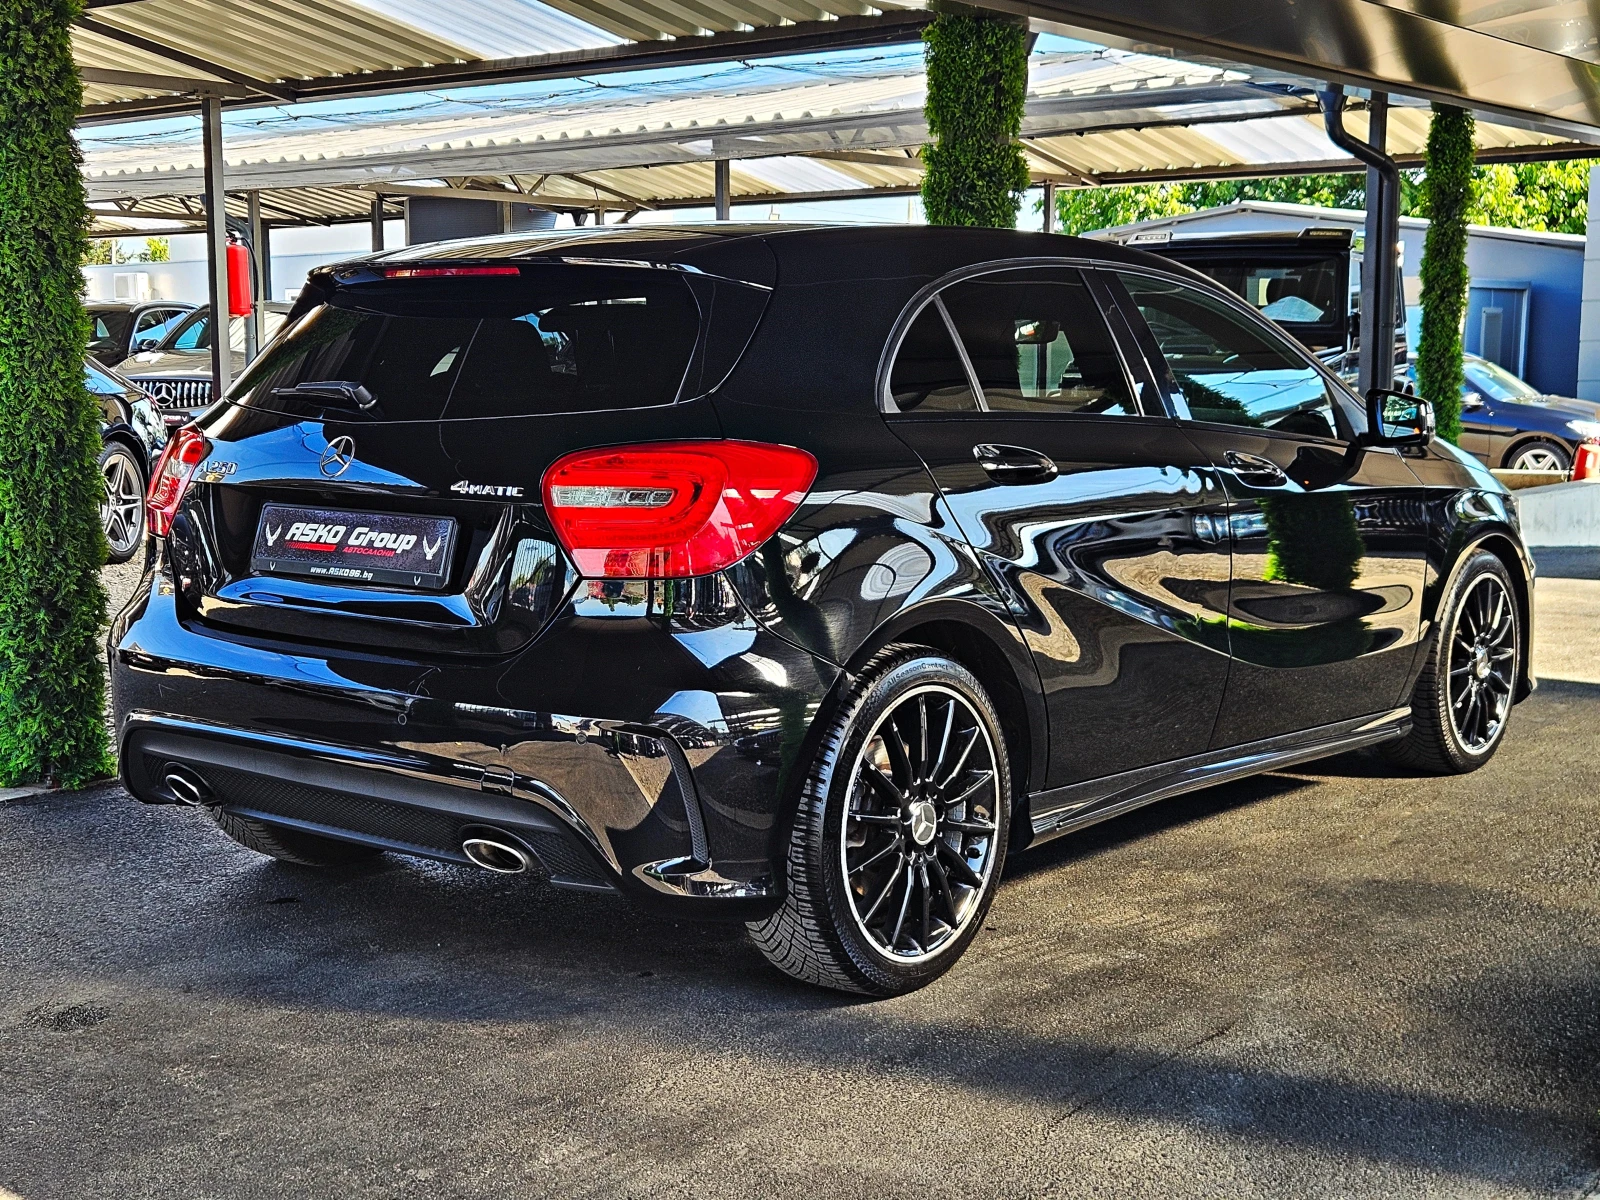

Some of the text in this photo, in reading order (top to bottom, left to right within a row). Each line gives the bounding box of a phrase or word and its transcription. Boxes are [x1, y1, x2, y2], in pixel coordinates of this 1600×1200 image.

[200, 460, 238, 475] A 250
[450, 480, 524, 497] 4MATIC
[285, 522, 418, 554] ASKO Group
[342, 546, 396, 558] АВТОСАЛОНИ
[886, 662, 949, 688] AllSeasonContact
